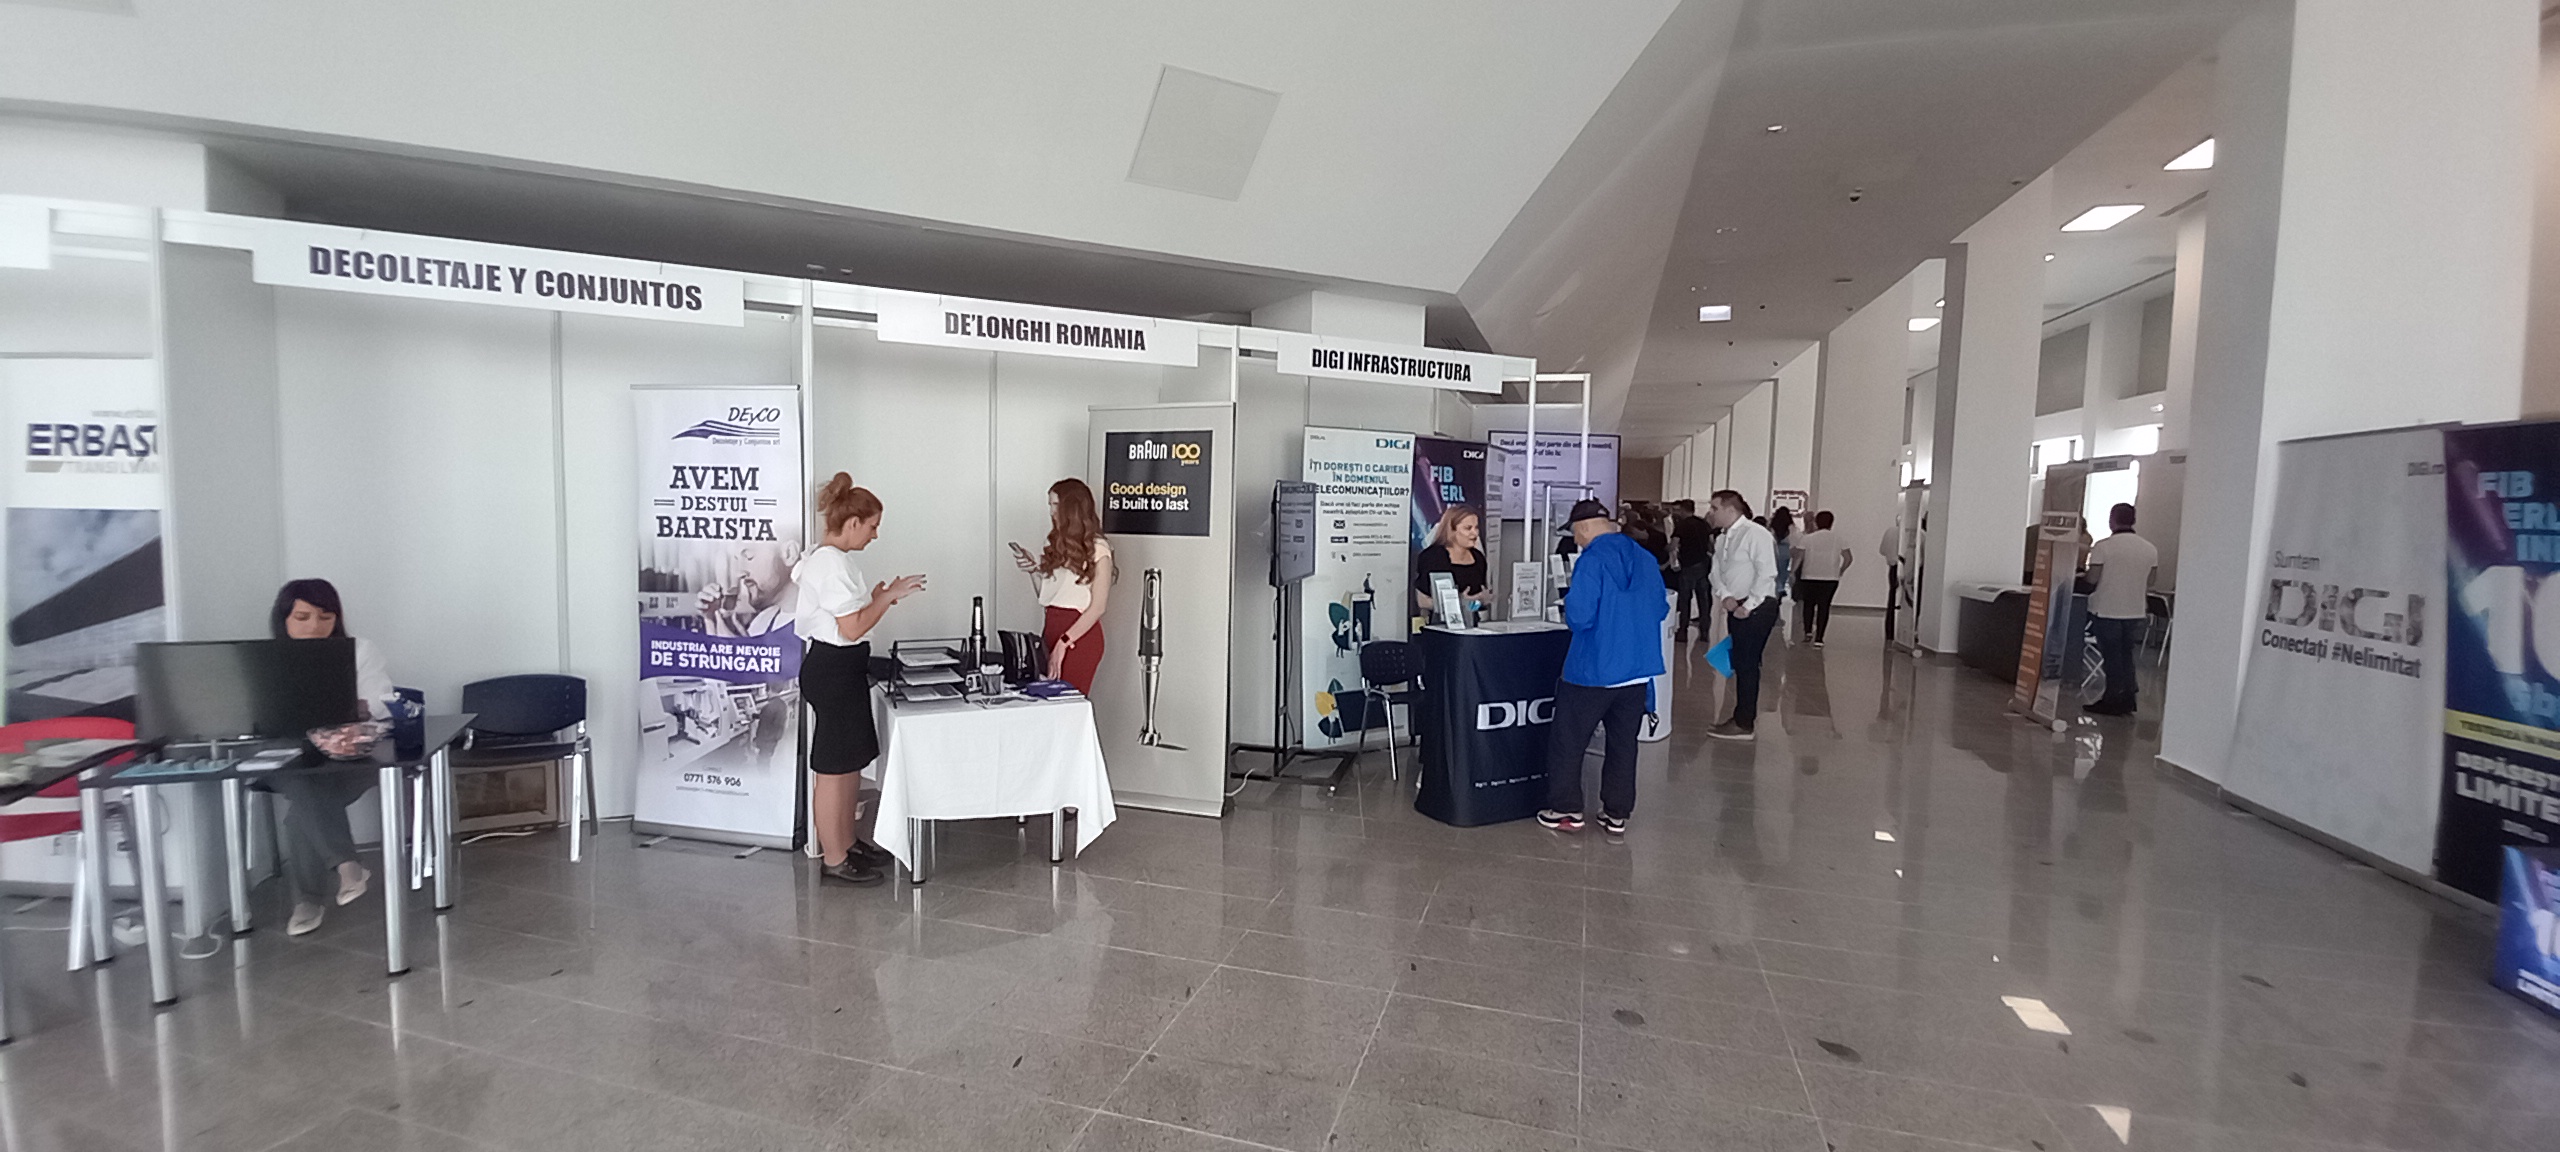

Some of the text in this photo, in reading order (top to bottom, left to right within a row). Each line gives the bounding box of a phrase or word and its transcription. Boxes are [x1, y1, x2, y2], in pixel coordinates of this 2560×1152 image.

[308, 245, 703, 311] DECOLETAJE Y CONJUNTOS
[944, 311, 1146, 351] DE'LONGHI ROMANIA
[1311, 348, 1472, 382] DIGI INFRASTRUCTURA
[728, 407, 780, 425] DEyCO
[27, 423, 158, 457] ERBAS
[1375, 438, 1411, 450] DIGI
[1128, 440, 1201, 460] BRAUN 100
[1463, 450, 1484, 460] DIGI
[1181, 459, 1200, 467] years
[1364, 463, 1371, 473] O
[669, 465, 760, 491] AVEM
[1344, 473, 1390, 485] DOMENIUL
[1430, 465, 1454, 483] FIB
[1110, 482, 1187, 498] Good design
[1315, 485, 1410, 498] ELECOMUNICAȚIILOR?
[2476, 470, 2535, 499] FIB
[681, 496, 747, 512] DESTUI
[1109, 497, 1190, 511] is built to last
[656, 515, 777, 541] BARISTA
[2273, 550, 2320, 571] Suntem
[2264, 578, 2426, 647] DIGI
[651, 639, 781, 658] INDUSTRIA ARE NEVOIE
[651, 651, 781, 673] DE STRUNGARI
[2331, 642, 2422, 679] #Nelimitat
[684, 772, 704, 783] 0771
[724, 776, 742, 787] 906
